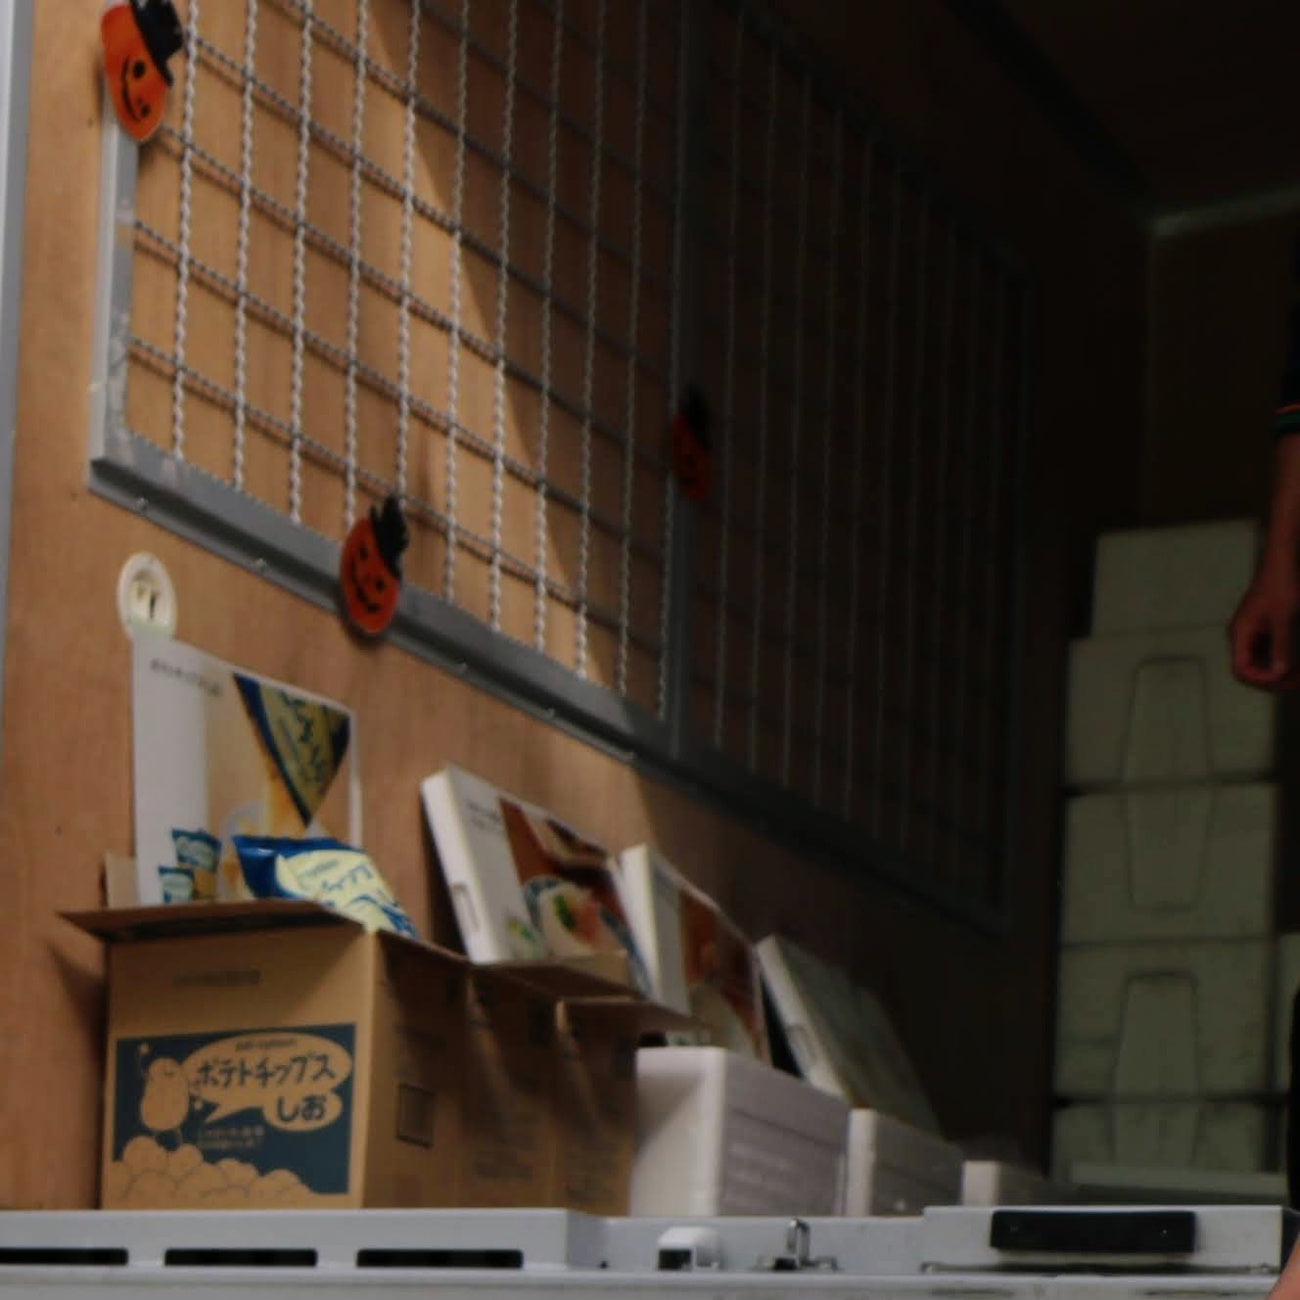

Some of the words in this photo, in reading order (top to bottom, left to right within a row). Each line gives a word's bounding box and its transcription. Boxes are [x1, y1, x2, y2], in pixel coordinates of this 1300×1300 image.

[195, 1050, 336, 1089] ポテトチップス
[277, 1094, 327, 1122] しお
